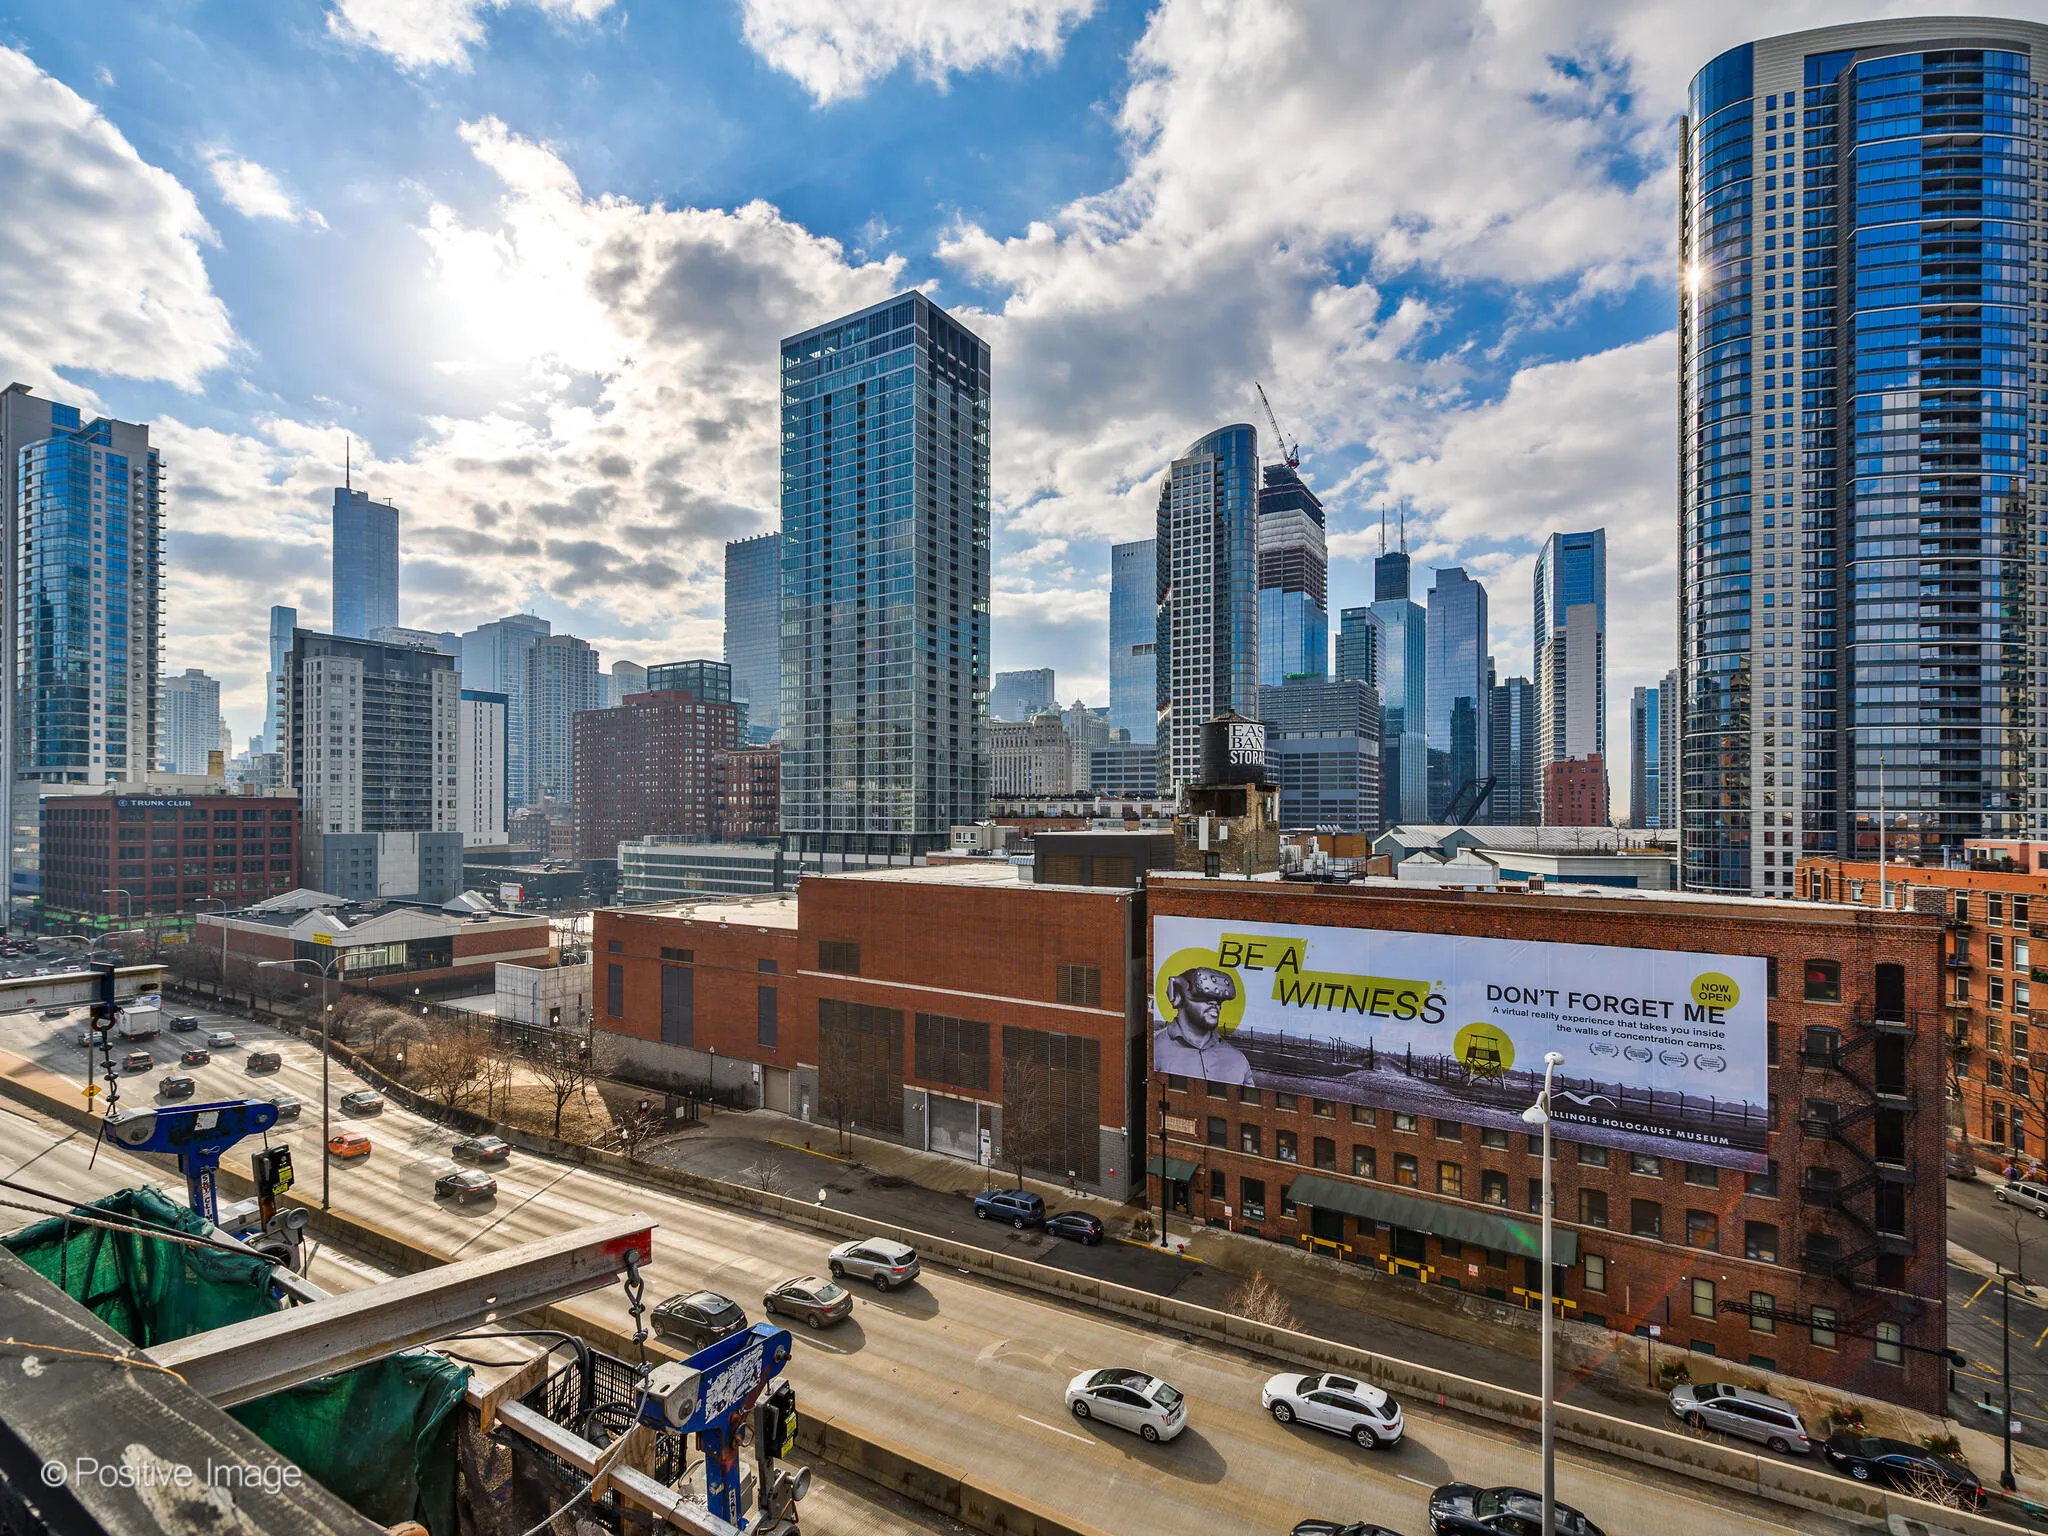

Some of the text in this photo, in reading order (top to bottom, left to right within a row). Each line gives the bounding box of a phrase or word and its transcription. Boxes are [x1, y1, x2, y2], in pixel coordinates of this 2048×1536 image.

[1218, 940, 1299, 974] BE A
[1279, 978, 1447, 1024] WITNESS
[1698, 991, 1731, 1002] OPEN
[1701, 983, 1729, 993] NOW
[1486, 984, 1726, 1025] DON'T FORGET ME
[1502, 1008, 1528, 1016] virtual
[1531, 1011, 1559, 1021] reality
[1562, 1014, 1614, 1026] experience
[1617, 1020, 1637, 1029] that
[1640, 1021, 1667, 1032] takes
[1671, 1027, 1689, 1035] you
[1693, 1028, 1725, 1038] inside
[1556, 1024, 1726, 1051] the walls of concentration camps.
[1550, 1110, 1729, 1144] ILLINOIS HOLOCAUST MUSEUM
